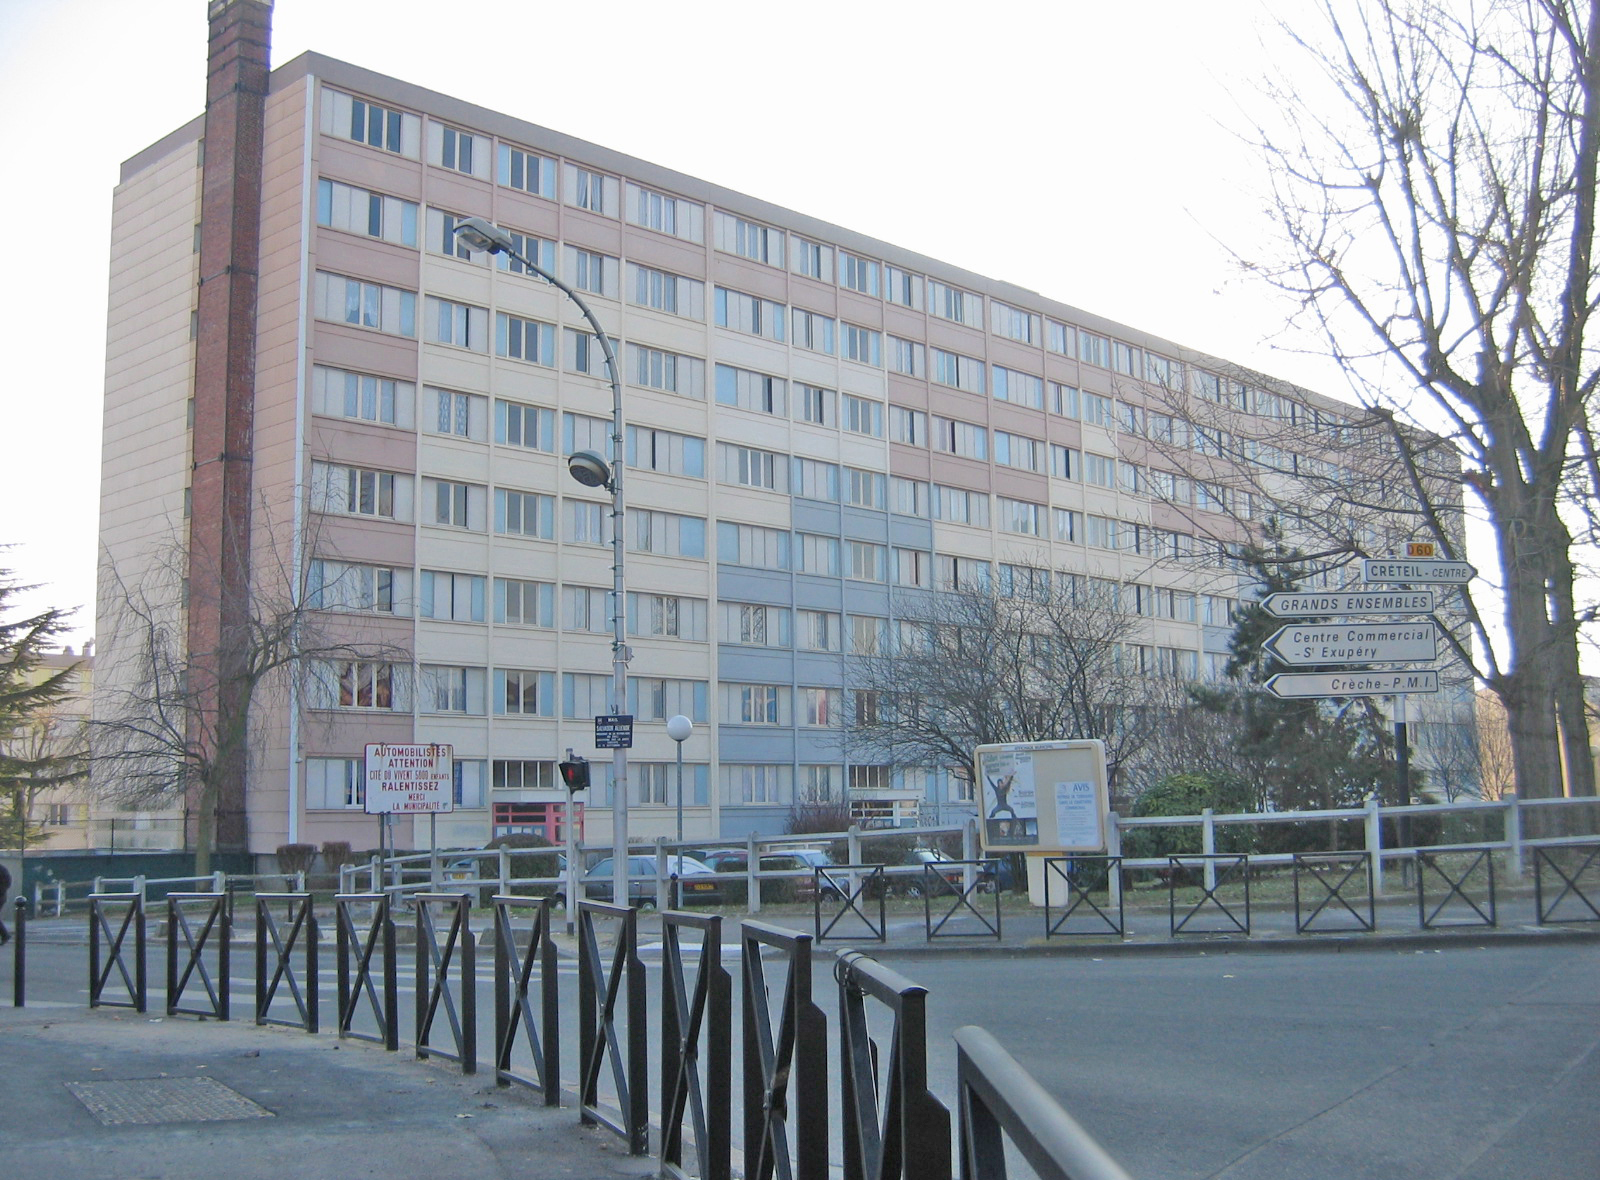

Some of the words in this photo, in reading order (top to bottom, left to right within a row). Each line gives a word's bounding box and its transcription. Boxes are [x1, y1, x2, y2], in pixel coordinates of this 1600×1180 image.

[1416, 544, 1433, 556] 60
[1370, 564, 1423, 577] CRÉTEIL
[1432, 568, 1467, 578] CENTRE
[1281, 598, 1339, 611] GRANDS
[1347, 596, 1428, 609] ENSEMBLES
[1293, 631, 1339, 643] Centre
[1347, 628, 1429, 641] Commercial
[1321, 645, 1377, 660] Exupéry
[374, 747, 447, 757] AUTOMOBILISTES
[388, 758, 434, 768] ATTENTION
[394, 770, 413, 780] VIVENT
[381, 782, 439, 792] RALENTISSEZ
[1072, 783, 1090, 792] AVIS
[408, 793, 426, 801] MERCI
[392, 803, 400, 811] LA
